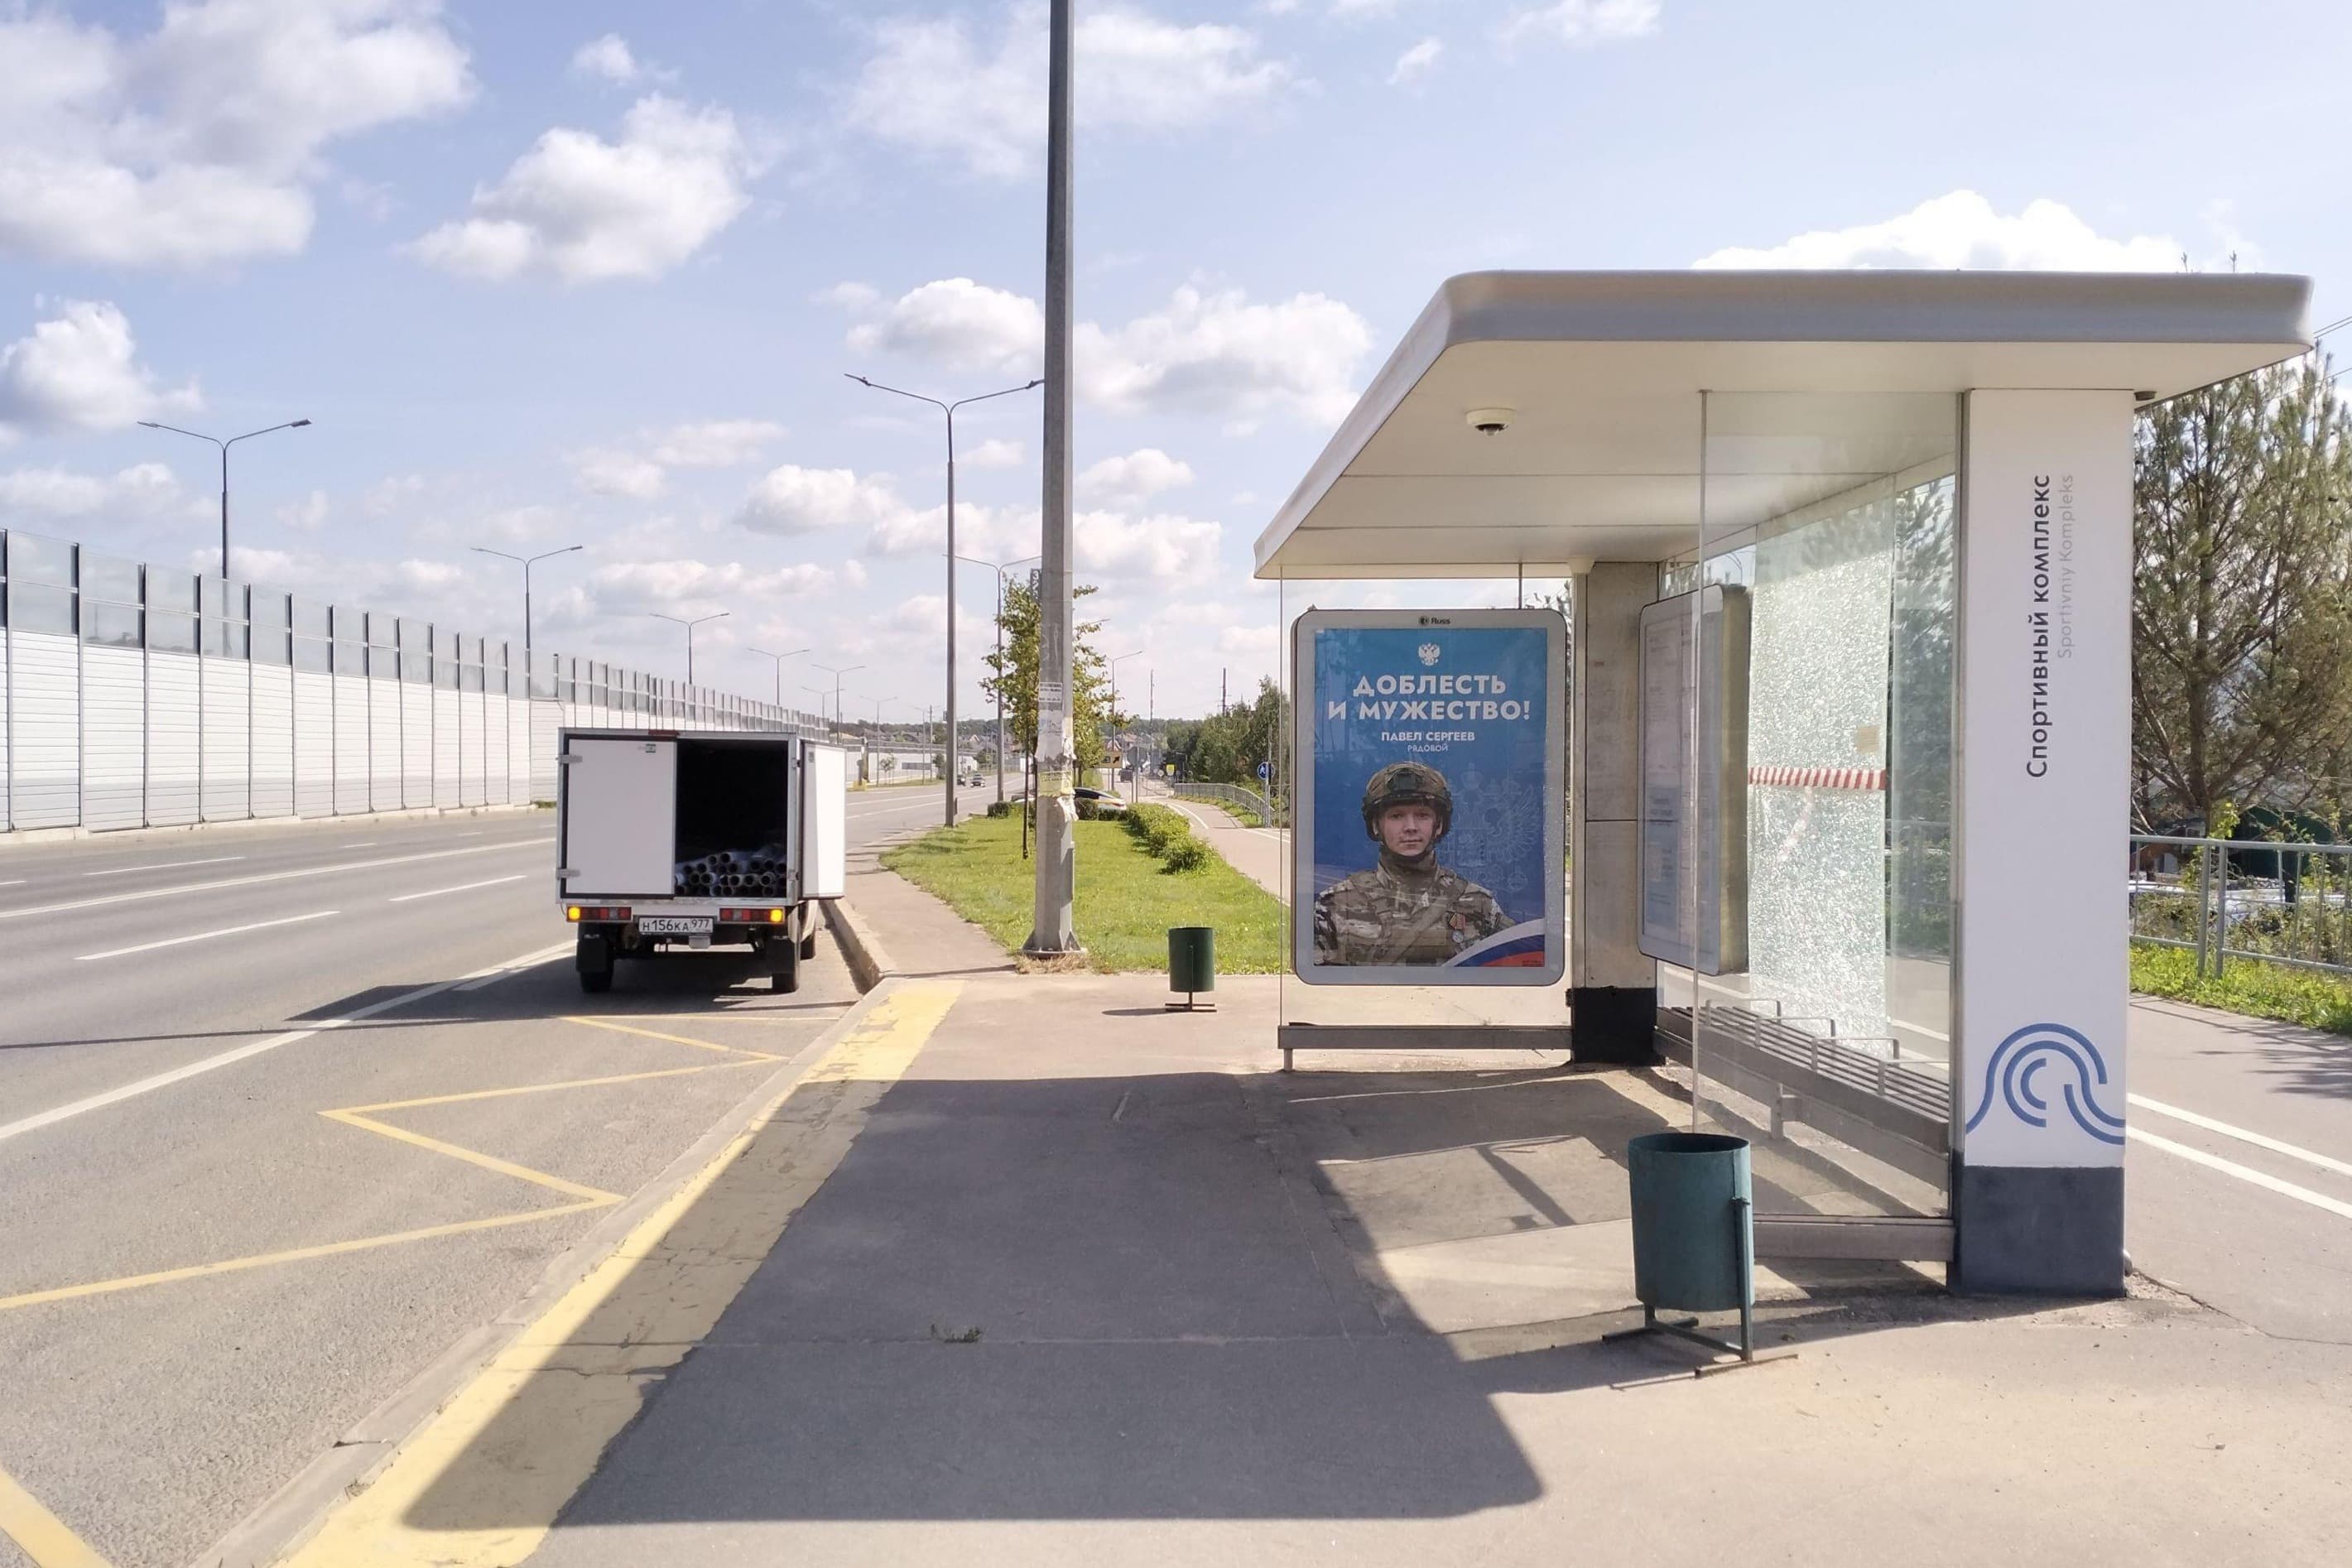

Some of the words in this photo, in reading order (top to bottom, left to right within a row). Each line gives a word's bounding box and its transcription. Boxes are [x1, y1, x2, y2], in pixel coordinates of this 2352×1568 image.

[2033, 474, 2050, 603] комплекс
[2058, 475, 2076, 561] Kompleks
[2058, 565, 2076, 658] Sportivniy
[1328, 700, 1347, 721] И
[1359, 700, 1531, 721] МУЖЕСТВО!
[1353, 674, 1507, 697] ДОБЛЕСТЬ
[2026, 611, 2052, 778] Спортивный
[1381, 731, 1422, 742] ПАВЕЛ
[1426, 731, 1476, 742] СЕРГЕЕВ
[1407, 743, 1449, 753] РЯДОВОЙ
